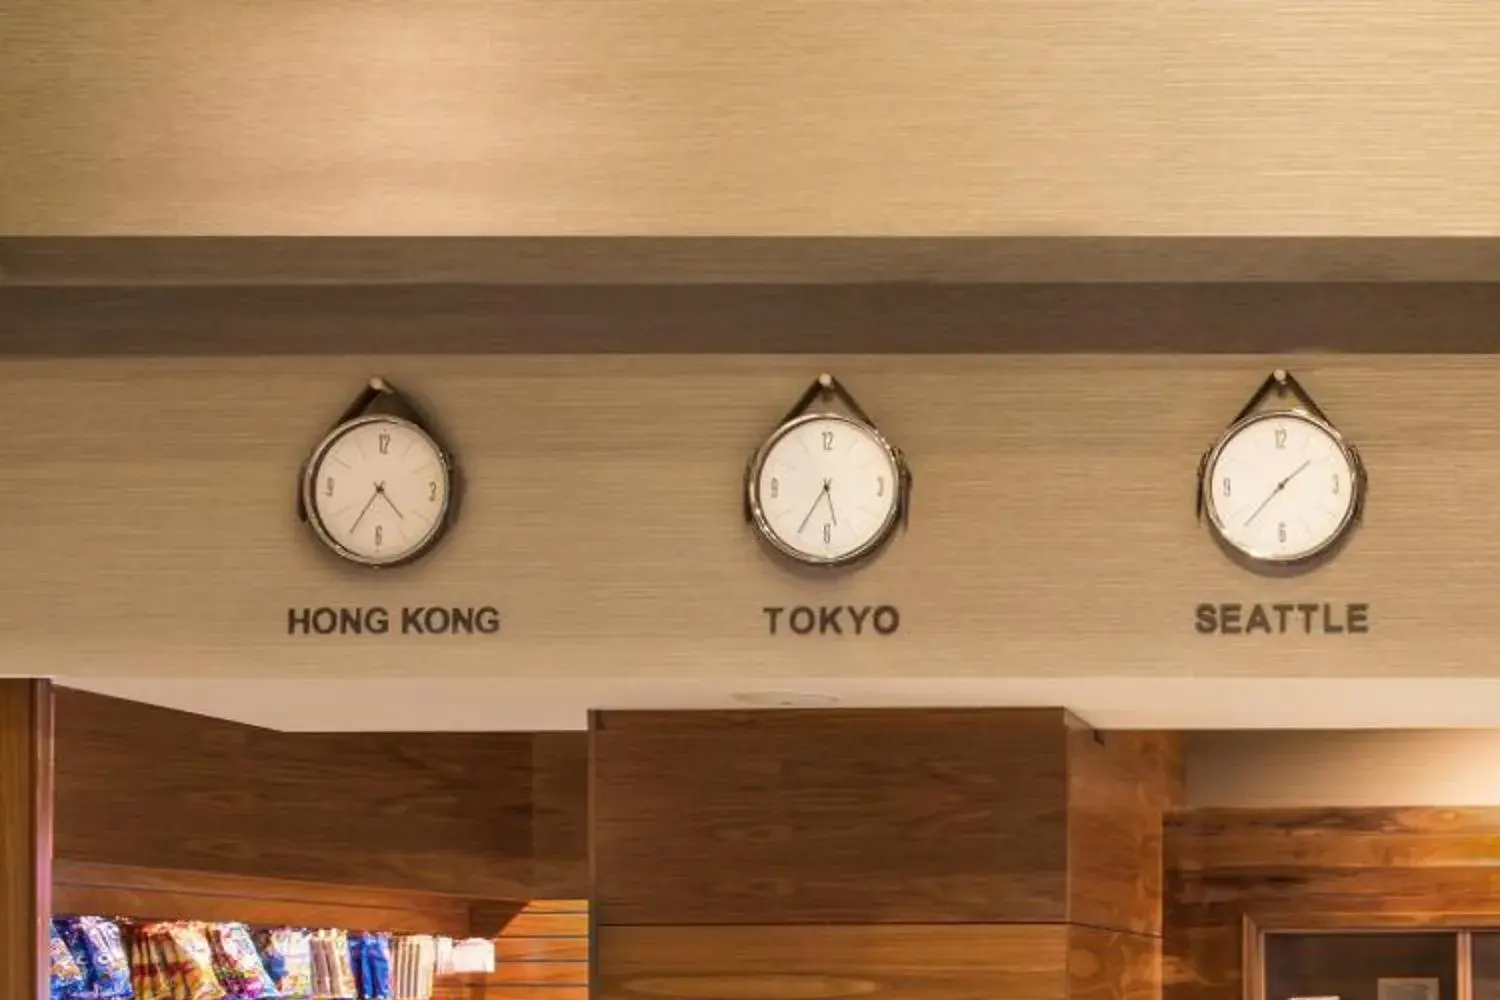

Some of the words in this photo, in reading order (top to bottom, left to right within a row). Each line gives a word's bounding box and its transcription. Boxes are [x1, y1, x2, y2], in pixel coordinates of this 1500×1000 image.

[379, 432, 391, 455] 12
[821, 431, 834, 451] 12
[1275, 428, 1287, 450] 12
[287, 606, 389, 635] HONG
[401, 606, 500, 635] KONG
[762, 604, 900, 636] TOKYO
[1194, 602, 1369, 635] SEATTLE
